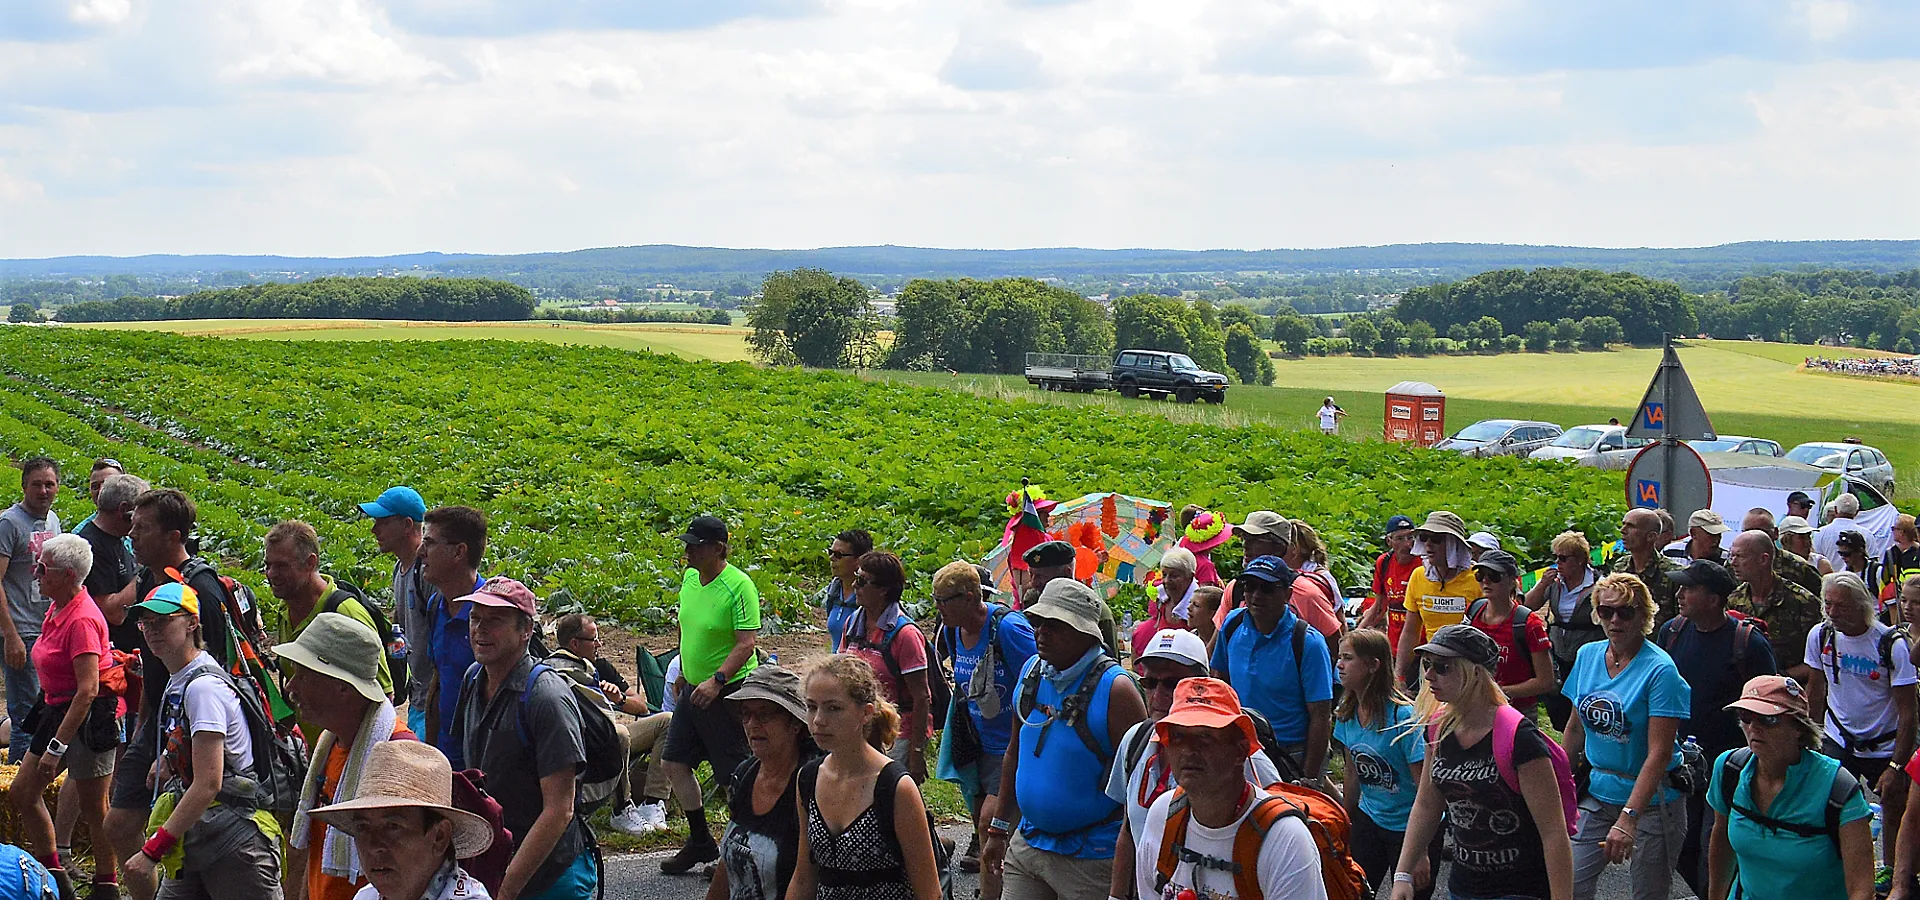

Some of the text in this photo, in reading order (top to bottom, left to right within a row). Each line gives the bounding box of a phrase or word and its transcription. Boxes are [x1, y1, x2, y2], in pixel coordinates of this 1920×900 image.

[1645, 406, 1664, 425] VA
[1639, 482, 1658, 503] VA
[1434, 598, 1454, 606] LIGHT
[1592, 709, 1610, 728] 99
[1360, 763, 1379, 779] 99
[1471, 848, 1520, 865] TRIP
